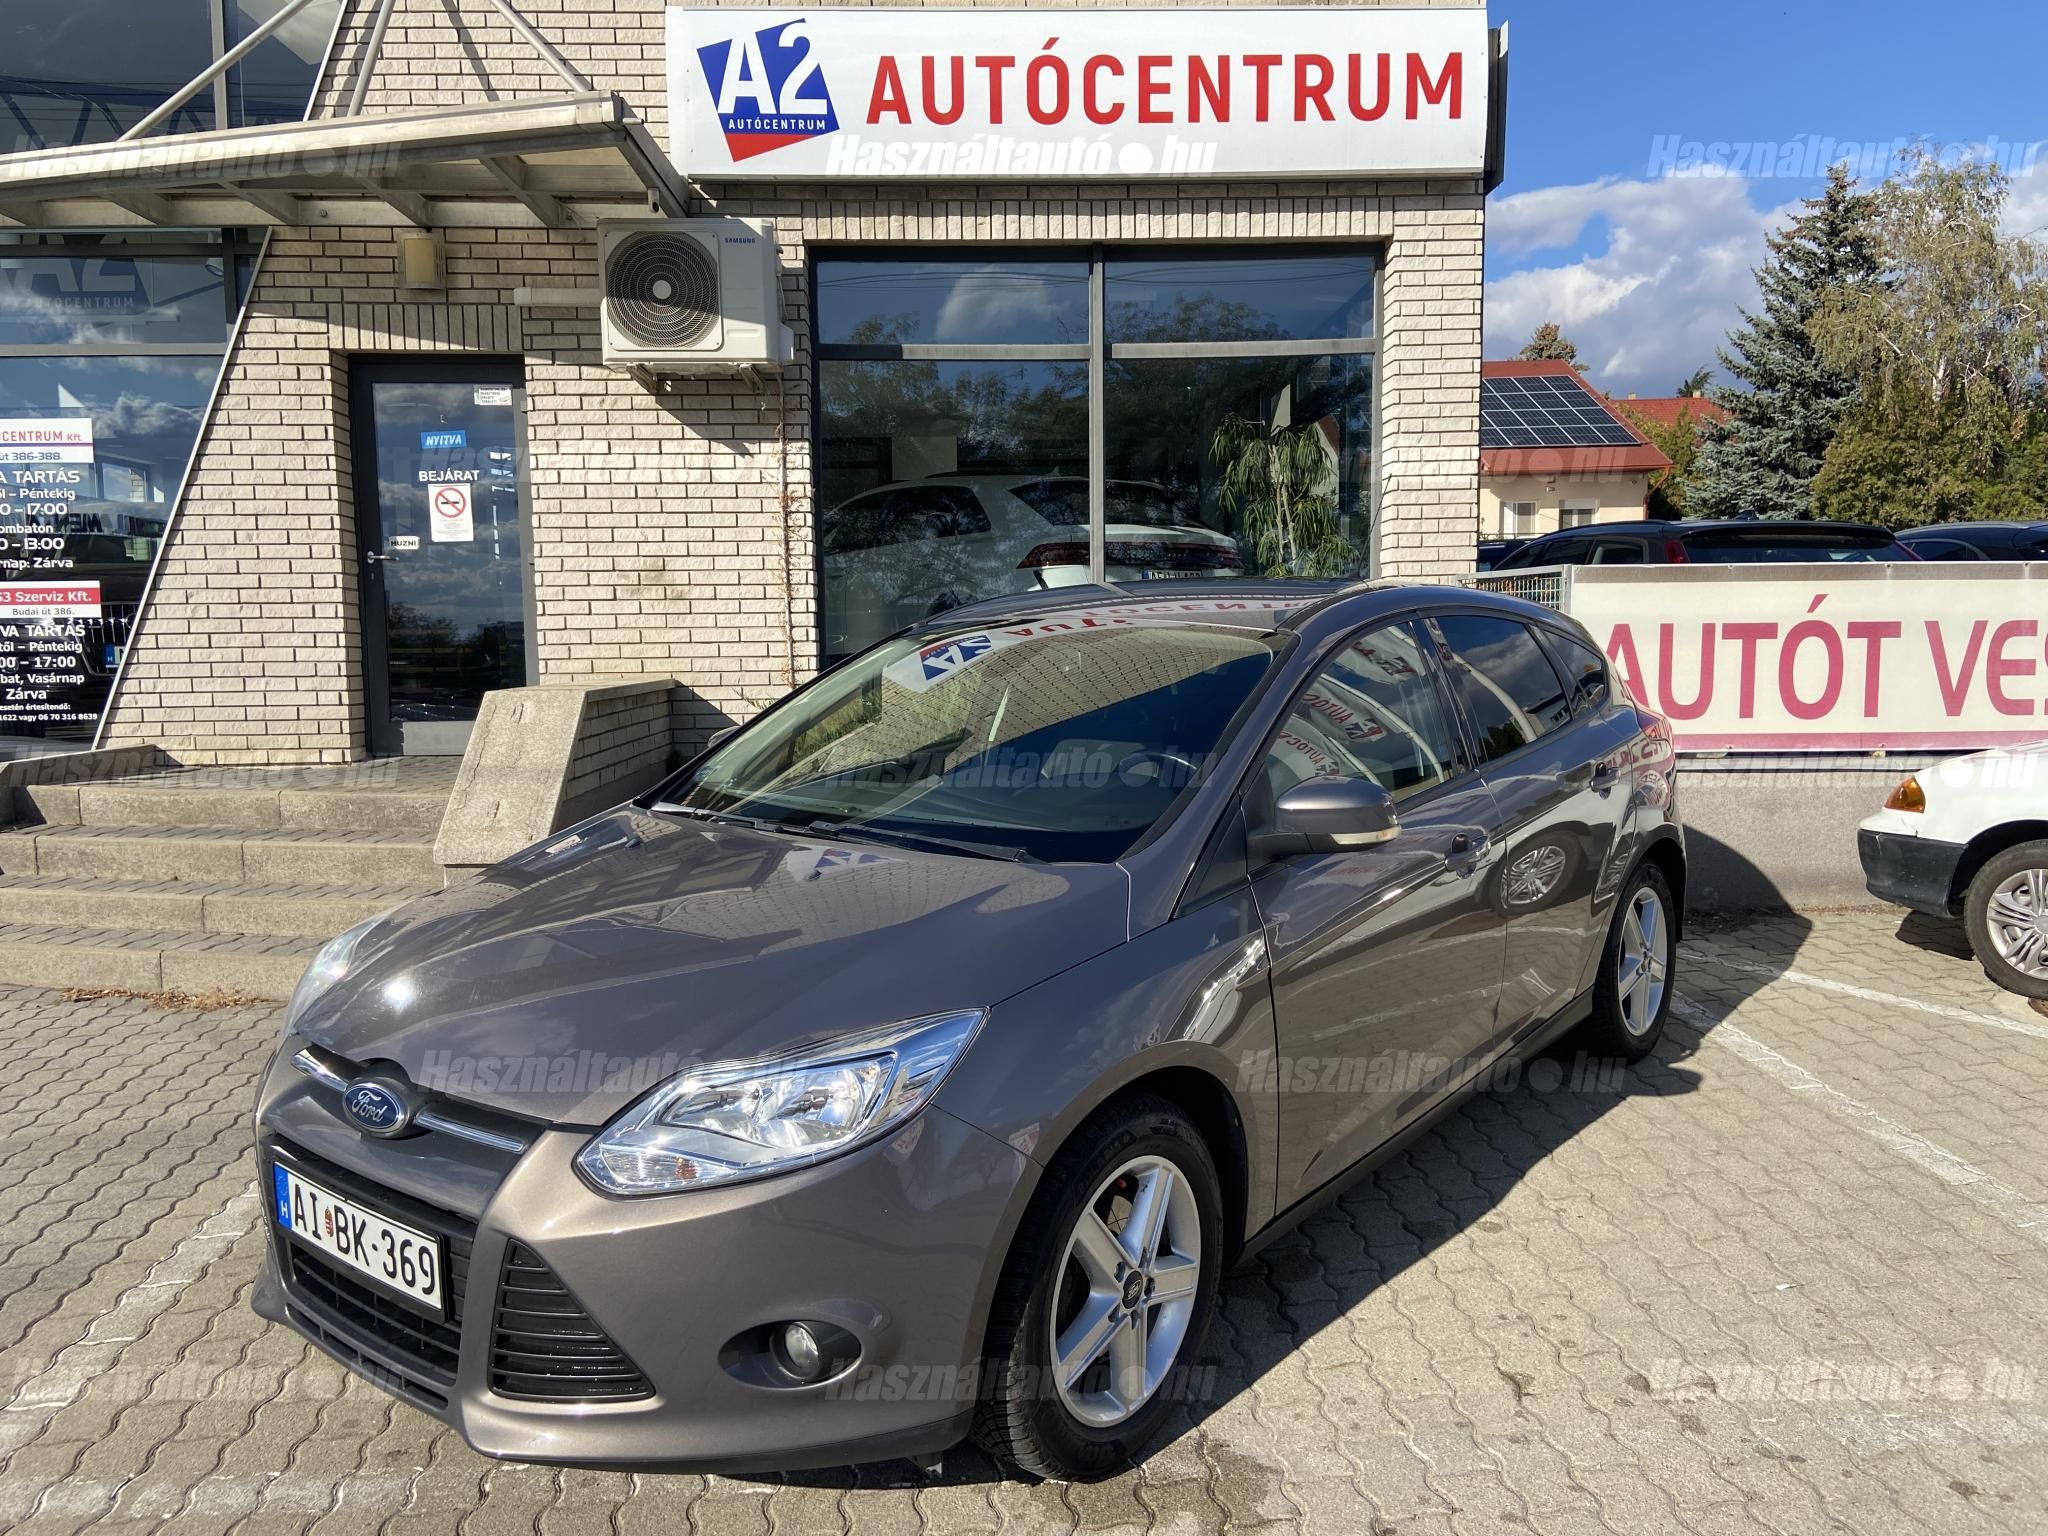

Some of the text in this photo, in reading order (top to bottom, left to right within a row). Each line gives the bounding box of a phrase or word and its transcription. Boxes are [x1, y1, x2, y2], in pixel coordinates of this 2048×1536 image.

[717, 20, 828, 115] A2
[866, 37, 1463, 126] AUTÓCENTRUM
[728, 116, 826, 131] AUTÓCENTRUM
[426, 435, 462, 447] NYITVA
[13, 467, 81, 483] TARTÁS
[418, 468, 480, 482] BEJÁRAT
[20, 488, 76, 501] Péntekig
[27, 503, 68, 515] 17:00
[25, 537, 65, 550] 13:00
[33, 557, 74, 569] Zárva
[15, 591, 64, 602] Szerviz
[68, 591, 93, 602] Kft.
[12, 607, 76, 616] Budai út 386.
[25, 621, 86, 637] TARTÁS
[29, 642, 83, 654] Péntekig
[34, 656, 77, 668] 17:00
[1606, 593, 2048, 722] AUTÓT VE
[27, 673, 85, 686] Vasárnap
[6, 688, 48, 700] Zárva
[26, 702, 71, 711] értesítendő:
[19, 714, 37, 723] vagy
[38, 713, 49, 721] 06
[51, 713, 61, 721] 70
[62, 713, 77, 721] 316
[78, 713, 98, 721] 8639
[351, 1089, 388, 1124] Ford
[280, 1202, 289, 1217] H
